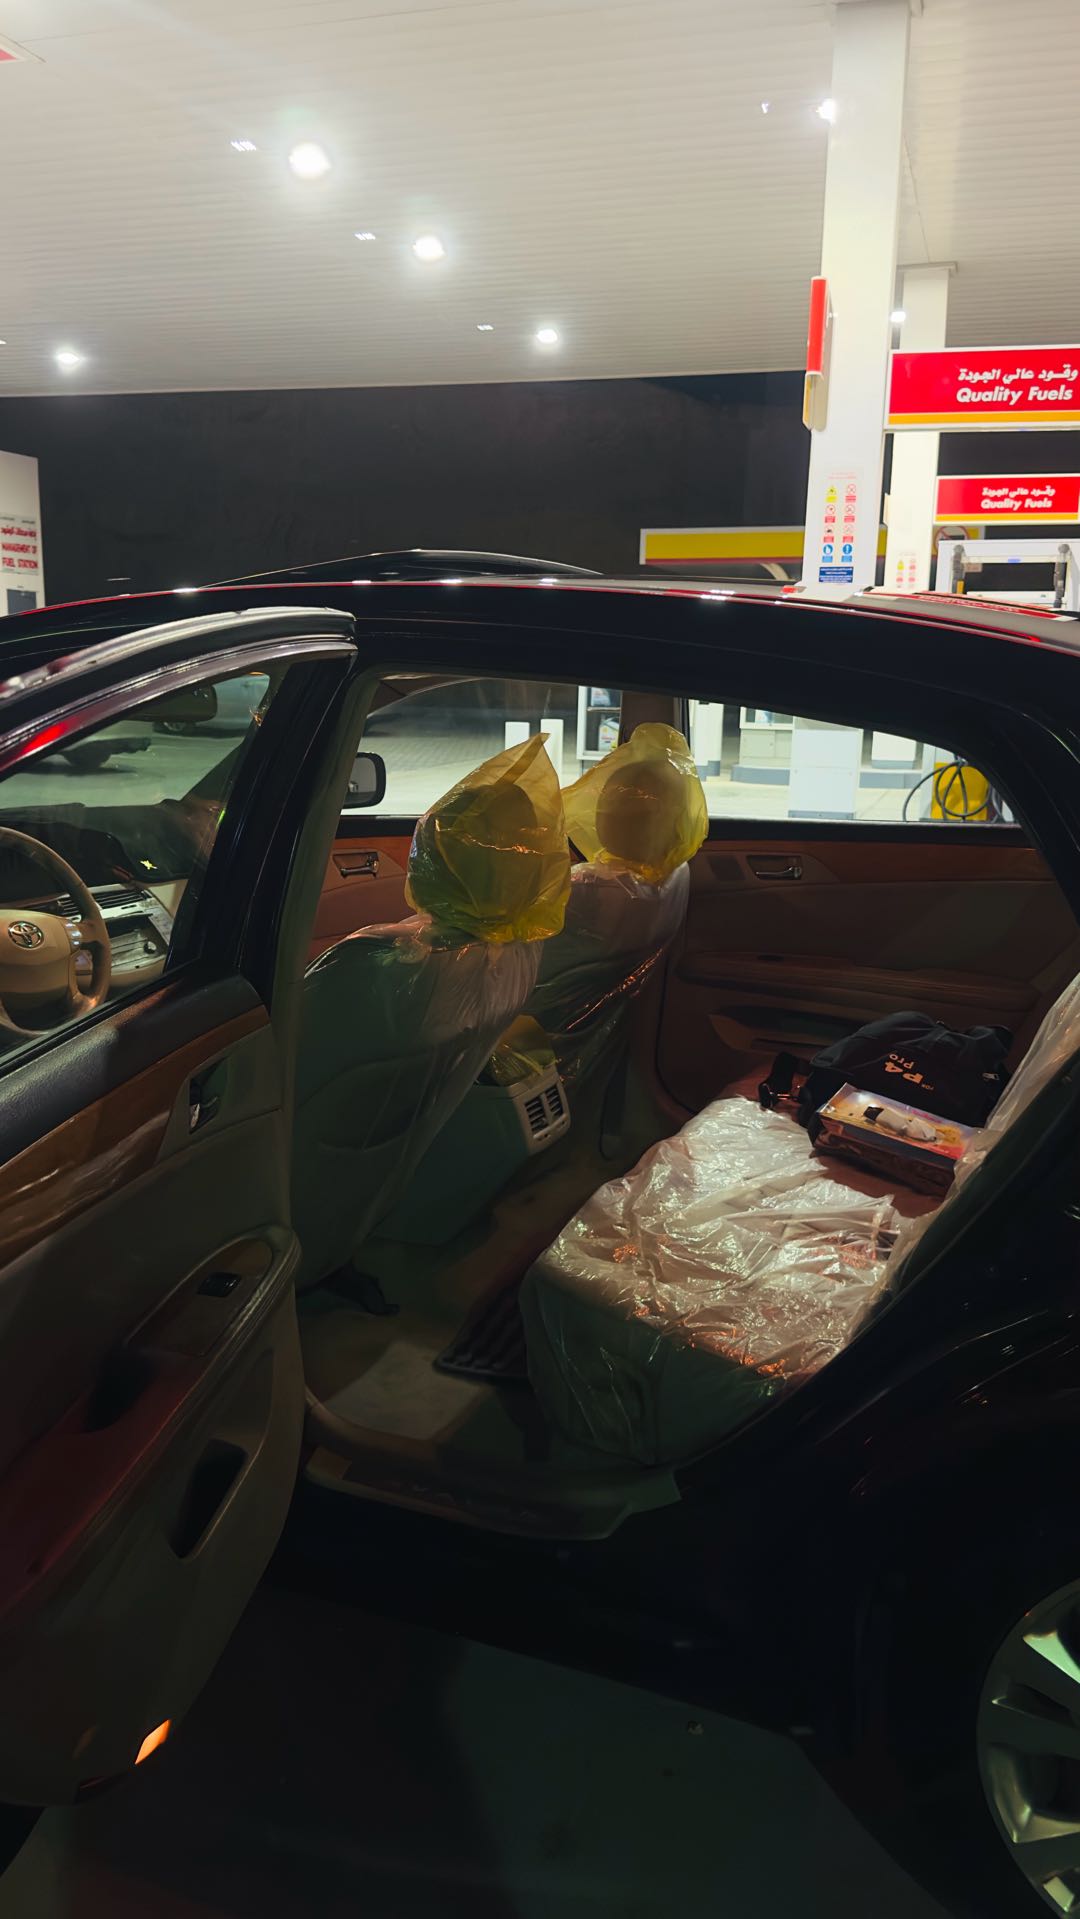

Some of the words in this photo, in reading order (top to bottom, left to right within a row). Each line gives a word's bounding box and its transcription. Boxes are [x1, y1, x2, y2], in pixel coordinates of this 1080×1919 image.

[958, 368, 1001, 383] الجودة
[1003, 368, 1035, 384] عالي
[956, 386, 1023, 405] Quality
[1028, 385, 1073, 401] Fuels
[981, 498, 1022, 510] Quality
[1024, 497, 1053, 508] Fuels
[2, 557, 15, 567] FUEL
[18, 559, 38, 569] STATION
[889, 1054, 914, 1069] Pro
[885, 1062, 923, 1083] P4
